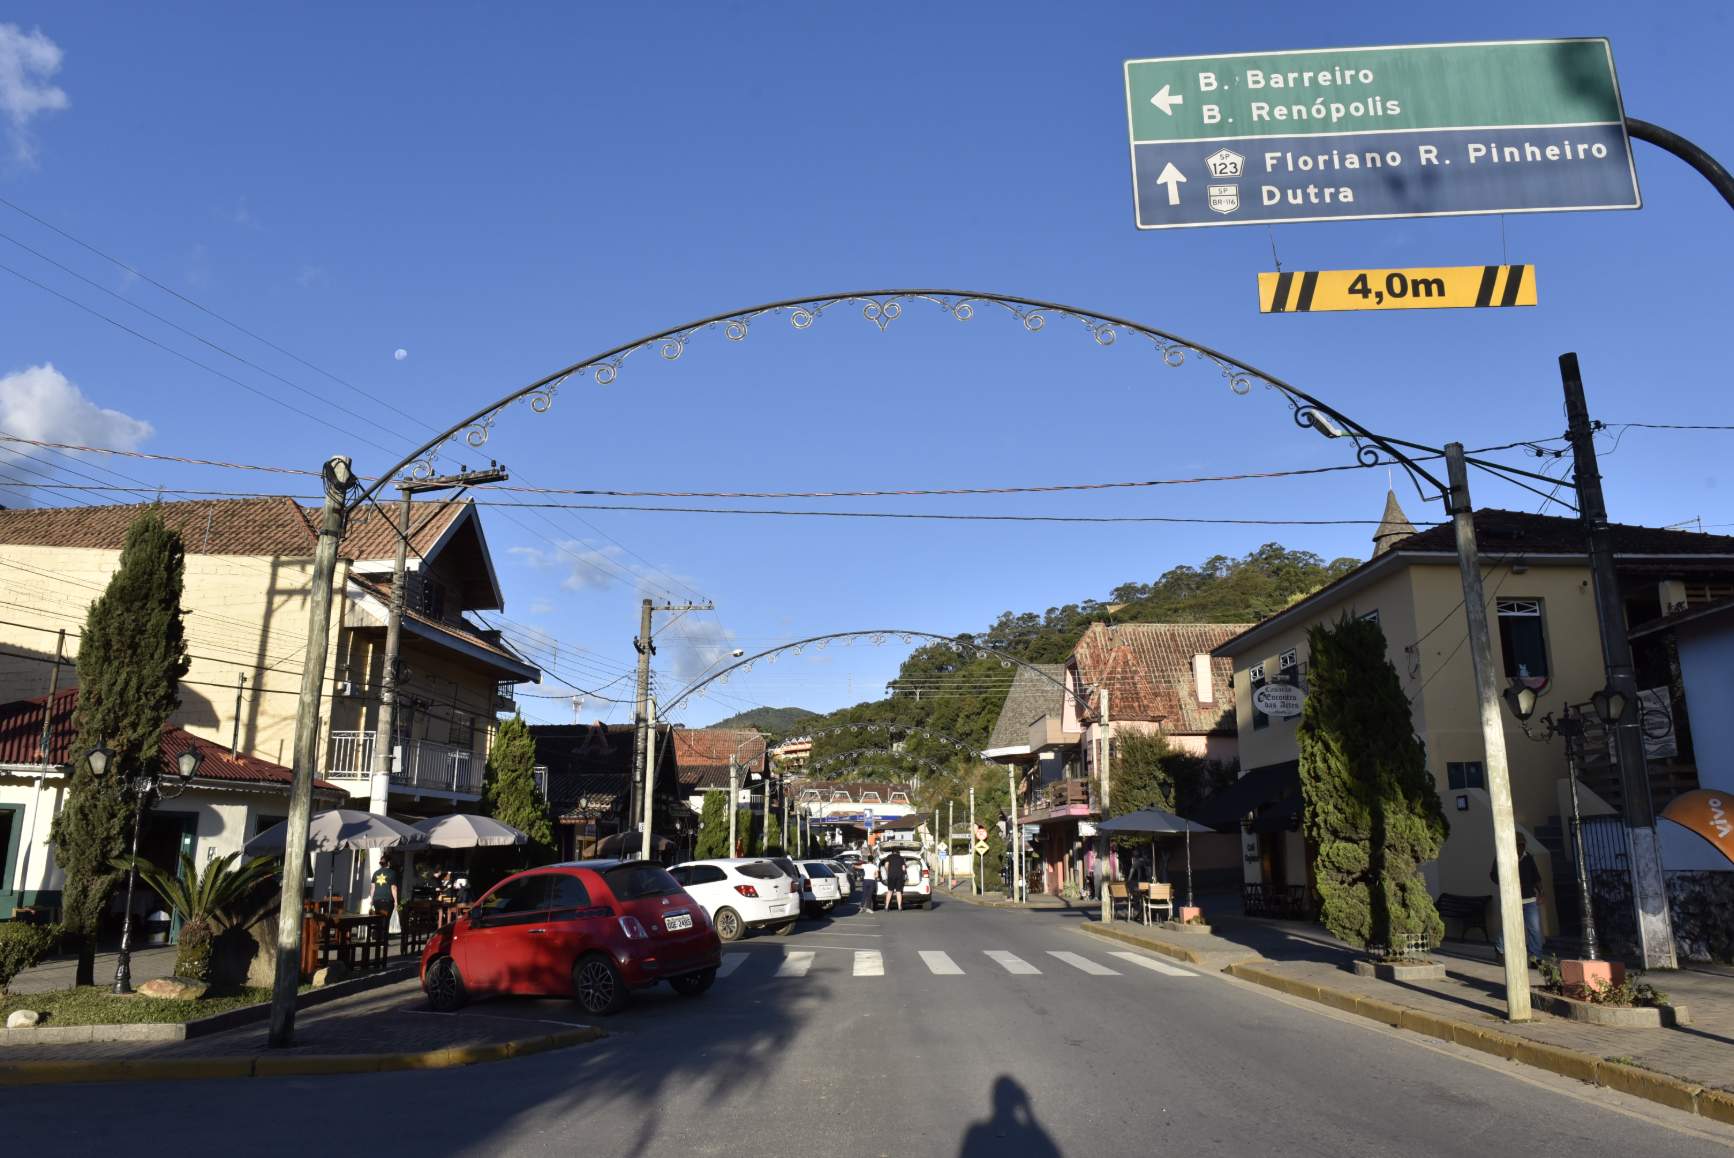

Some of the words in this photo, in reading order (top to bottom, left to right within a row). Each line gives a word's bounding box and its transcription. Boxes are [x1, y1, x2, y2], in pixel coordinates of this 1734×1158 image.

[1199, 72, 1229, 92] B.
[1246, 66, 1374, 89] Barreiro
[1202, 104, 1233, 124] B.
[1251, 96, 1401, 123] Renópolis
[1213, 162, 1239, 175] 123
[1219, 153, 1230, 161] SP
[1264, 150, 1402, 172] Floriano
[1418, 145, 1450, 165] R.
[1467, 141, 1607, 164] Pinheiro
[1212, 197, 1236, 206] BR-116
[1261, 184, 1354, 206] Dutra
[1347, 272, 1446, 305] 4,0m
[1708, 798, 1730, 838] vivo
